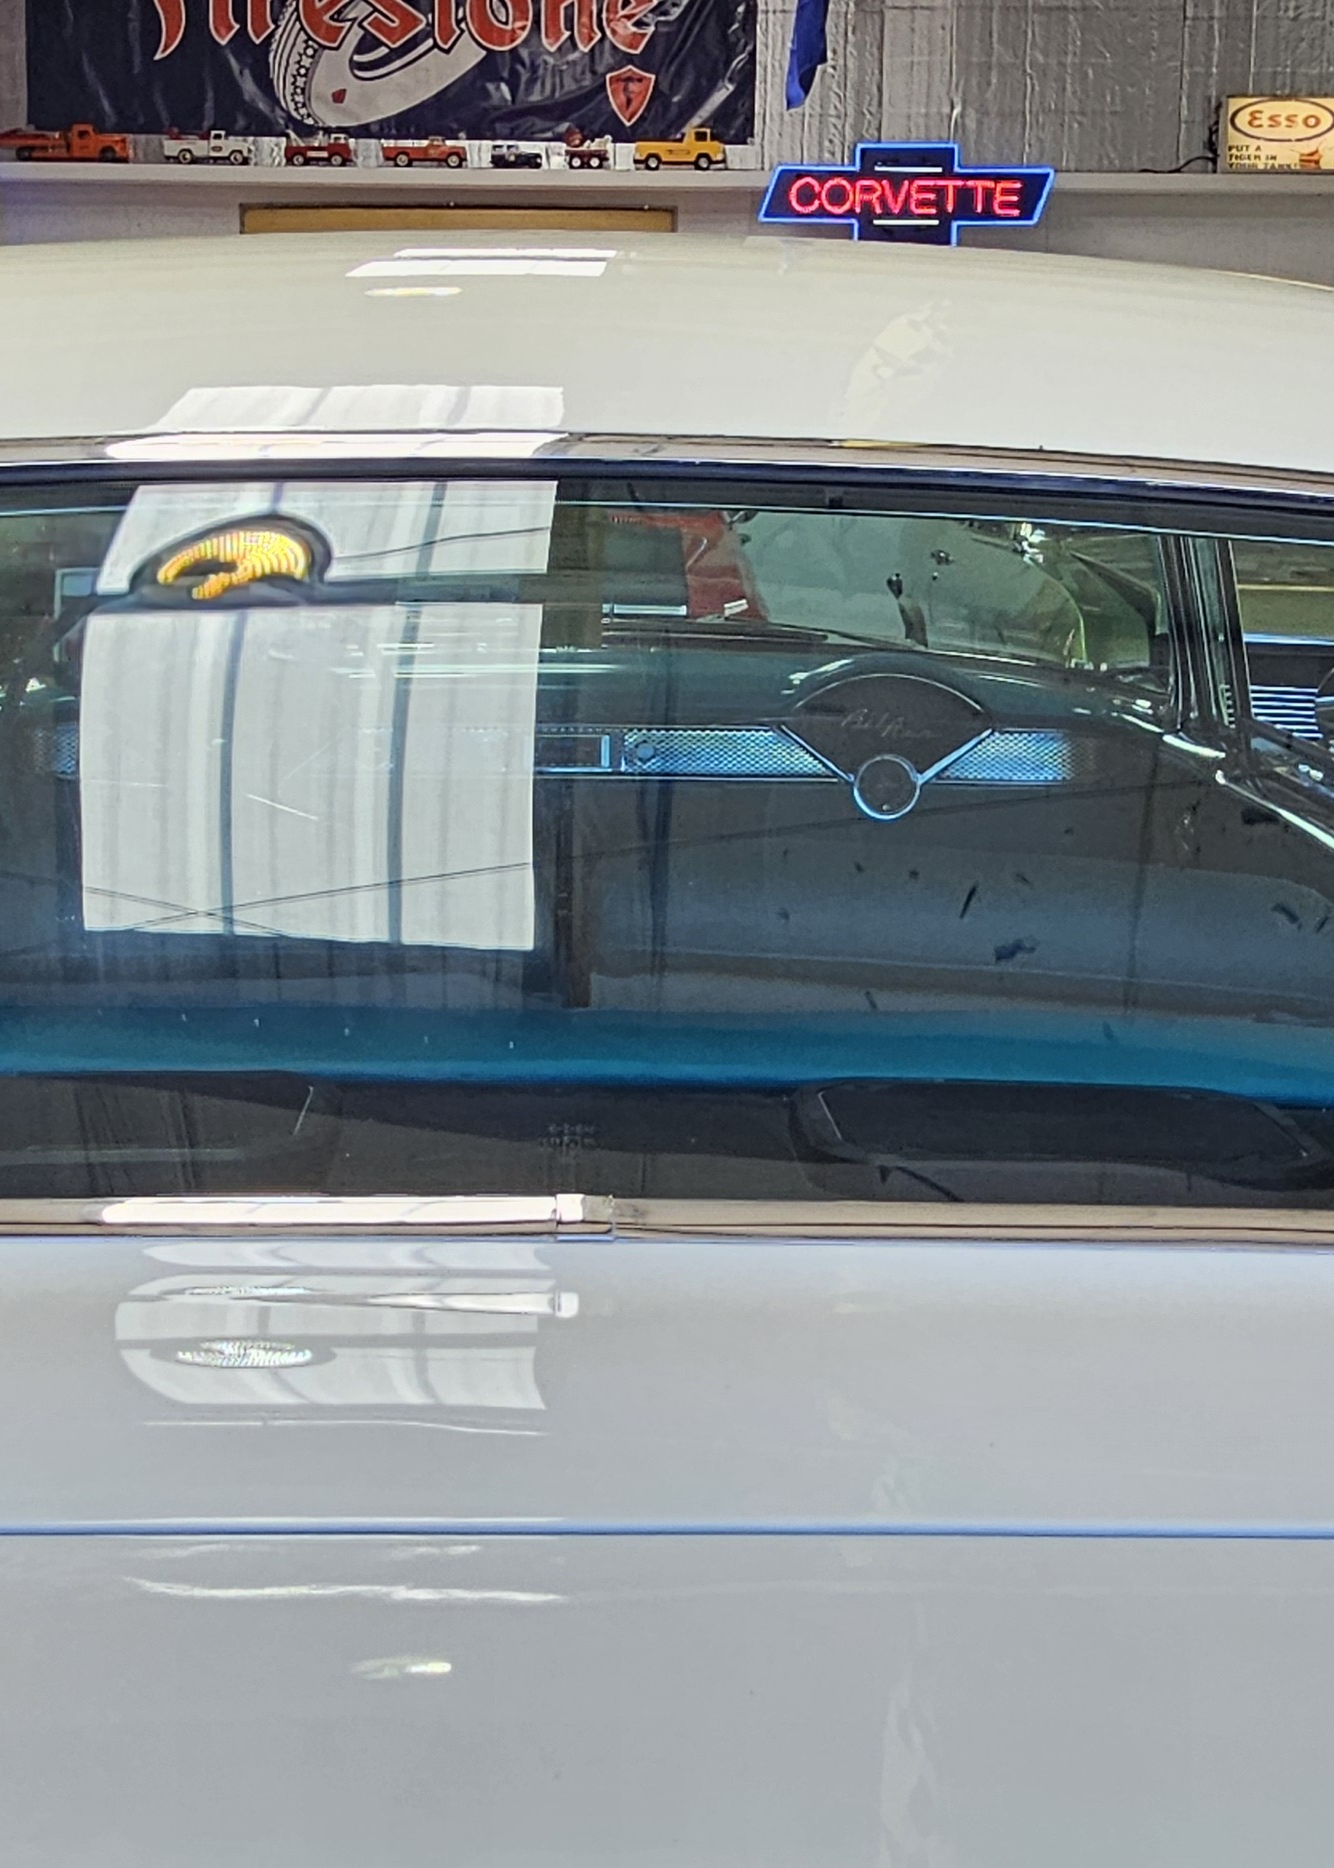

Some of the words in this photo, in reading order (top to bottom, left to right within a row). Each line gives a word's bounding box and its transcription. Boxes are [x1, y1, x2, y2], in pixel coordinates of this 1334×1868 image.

[1247, 110, 1321, 128] Esso
[1228, 145, 1250, 153] PUT
[788, 175, 1023, 217] CORVETTE
